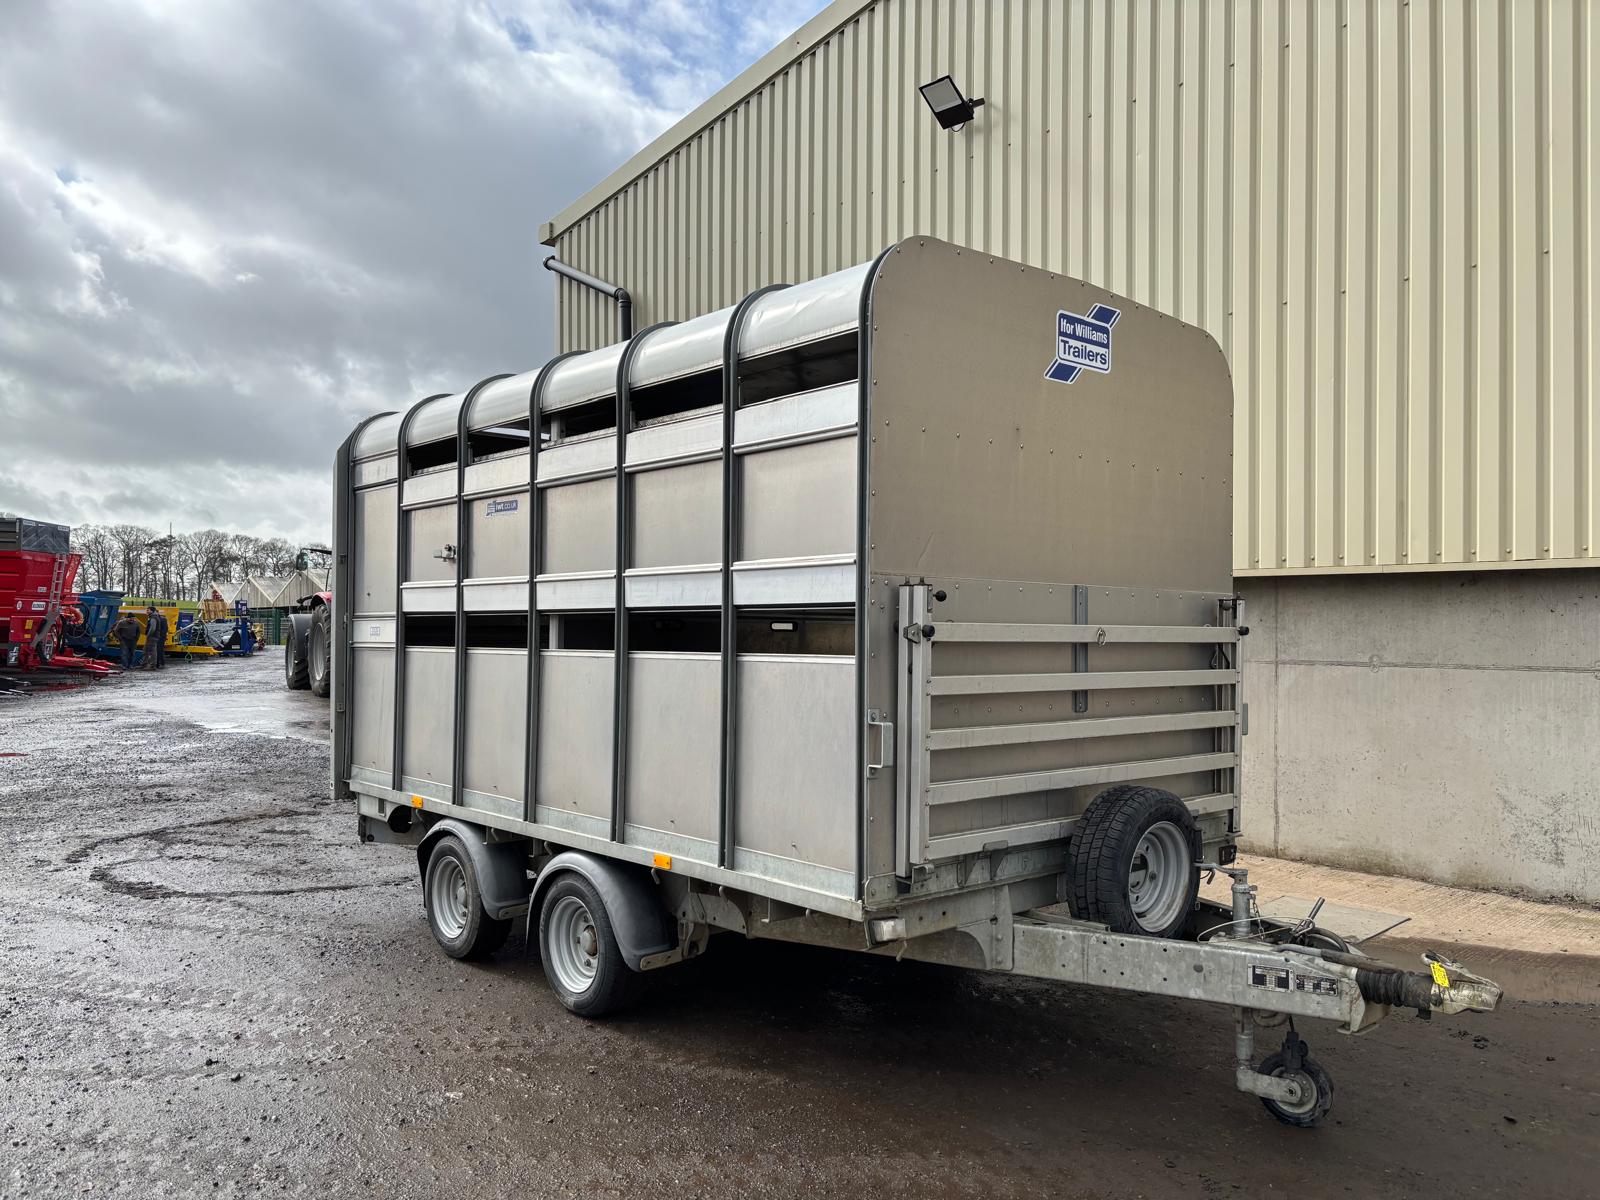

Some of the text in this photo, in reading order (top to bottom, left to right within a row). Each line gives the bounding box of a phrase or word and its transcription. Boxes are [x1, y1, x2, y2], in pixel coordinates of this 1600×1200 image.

[1060, 318, 1108, 344] Ifor Williams
[1060, 339, 1107, 365] Trailers
